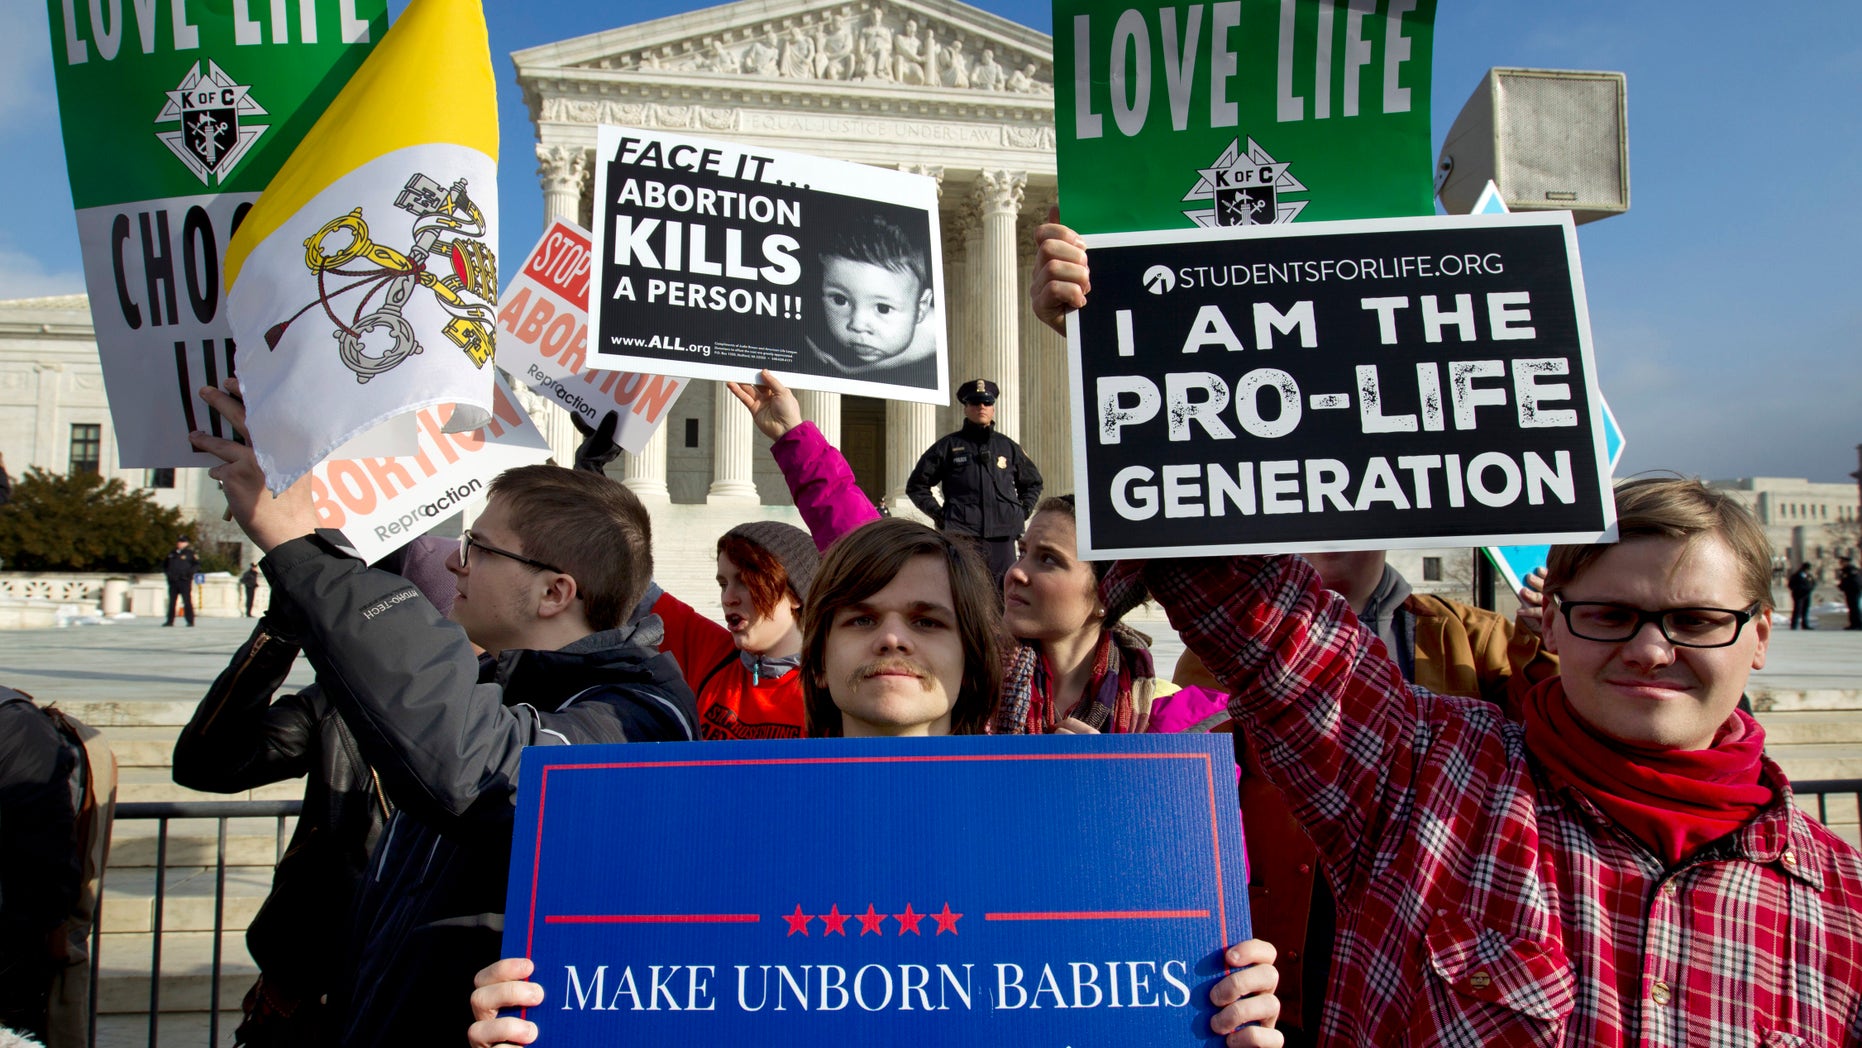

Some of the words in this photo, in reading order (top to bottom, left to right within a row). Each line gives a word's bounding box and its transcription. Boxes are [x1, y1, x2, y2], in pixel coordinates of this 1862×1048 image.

[1073, 1, 1242, 139] LOVE
[1276, 0, 1417, 123] LIFE
[181, 91, 195, 109] K
[198, 92, 216, 105] OF
[221, 88, 235, 106] C
[613, 136, 724, 175] FACE
[751, 116, 812, 132] EQUAL
[814, 117, 887, 137] JUSTICE
[893, 122, 952, 141] UNDER
[959, 127, 993, 143] LAW
[617, 178, 801, 227] ABORTION
[1215, 169, 1230, 188] K
[1234, 170, 1254, 184] OF
[1258, 166, 1274, 184] C
[533, 231, 592, 289] STOP
[614, 214, 802, 286] KILLS
[1180, 252, 1504, 290] STUDENTSFORLIFE.ORG
[612, 276, 637, 301] A
[647, 278, 803, 320] PERSON!!
[1116, 309, 1136, 357] I
[1181, 300, 1319, 355] AM
[1361, 291, 1537, 346] THE
[611, 334, 711, 357] www.ALL.org
[527, 363, 598, 419] Reproaction
[1096, 357, 1578, 445] PRO-LIFE
[373, 477, 483, 543] Reproaction
[1110, 450, 1576, 522] GENERATION
[561, 964, 717, 1012] MAKE
[734, 962, 976, 1012] UNBORN
[993, 959, 1192, 1011] BABIES
